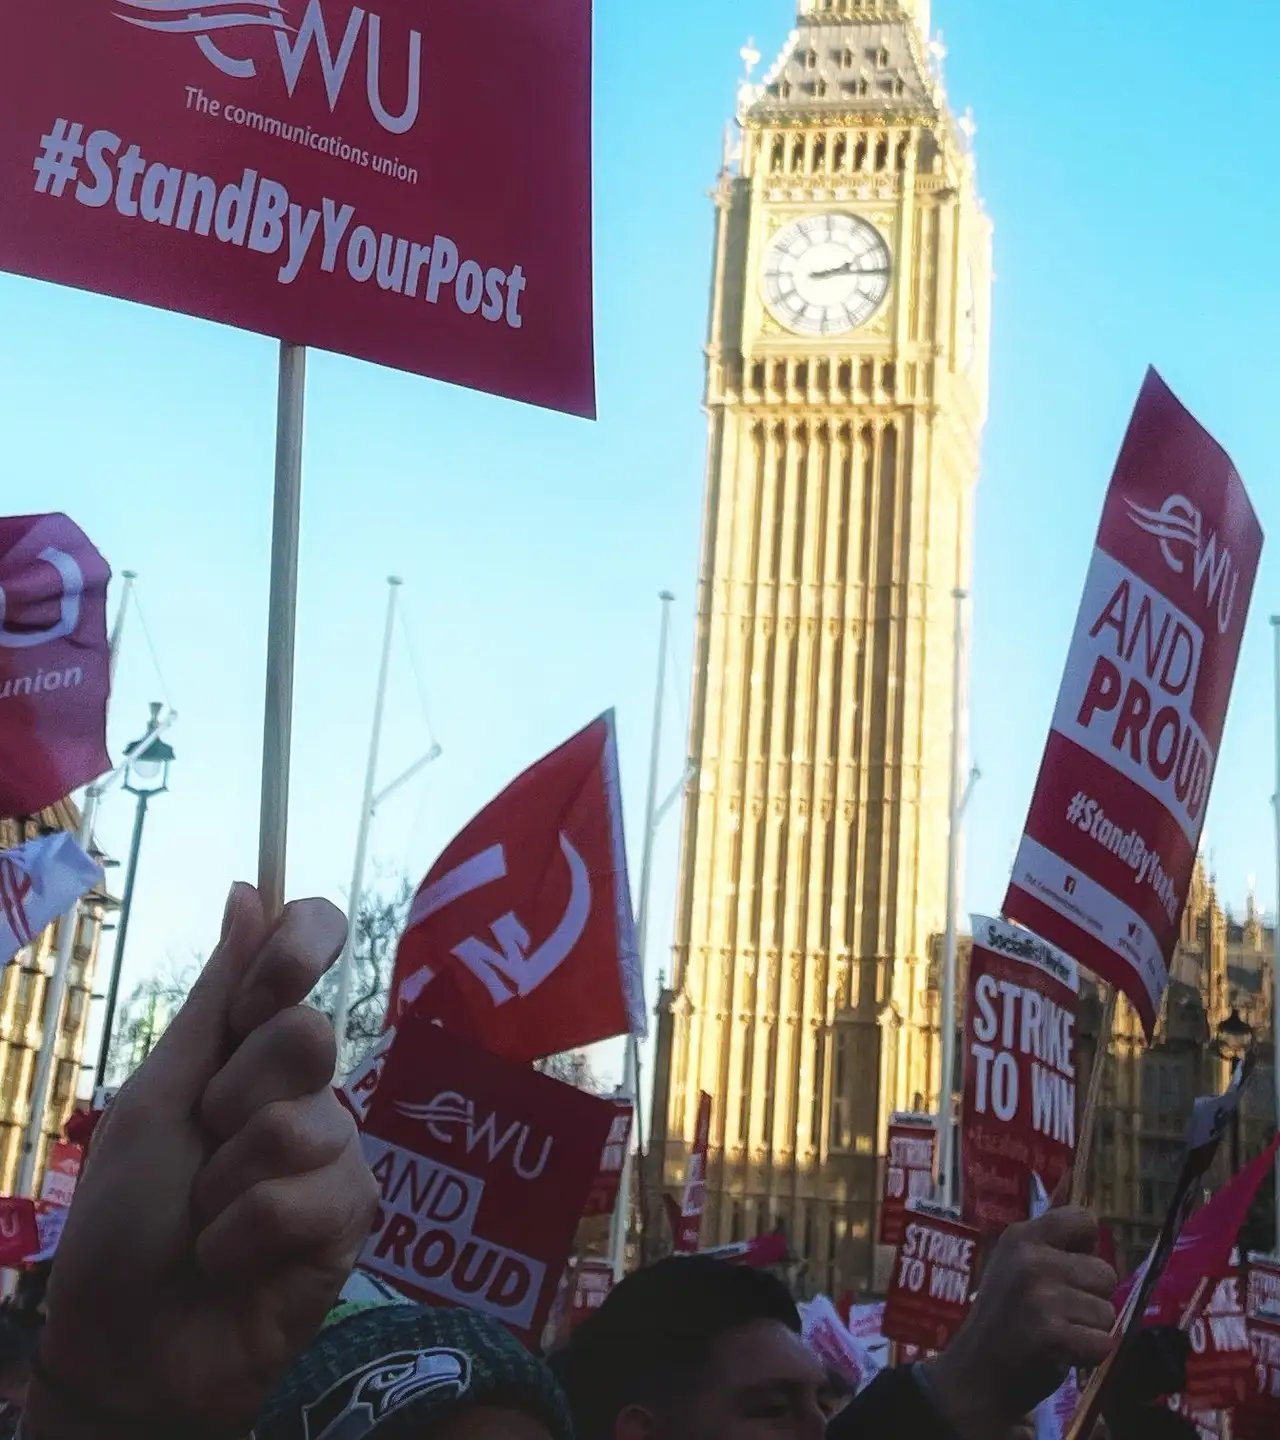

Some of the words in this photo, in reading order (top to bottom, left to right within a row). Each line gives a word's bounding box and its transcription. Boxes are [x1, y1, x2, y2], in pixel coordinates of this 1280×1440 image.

[183, 85, 220, 119] The
[223, 104, 370, 169] communications
[371, 152, 419, 186] union
[32, 117, 527, 329] #StandByYourPost
[1123, 494, 1240, 635] CWU
[1089, 579, 1193, 696] AND
[1076, 655, 1208, 822] PROUD
[973, 973, 1076, 1077] STRIKE
[393, 1091, 554, 1180] CWU
[971, 1042, 1019, 1122] TO
[1031, 1062, 1076, 1148] WIN
[372, 1150, 468, 1223] AND
[898, 1255, 926, 1292] TO
[929, 1264, 970, 1305] WIN
[903, 1222, 976, 1272] STRIKE
